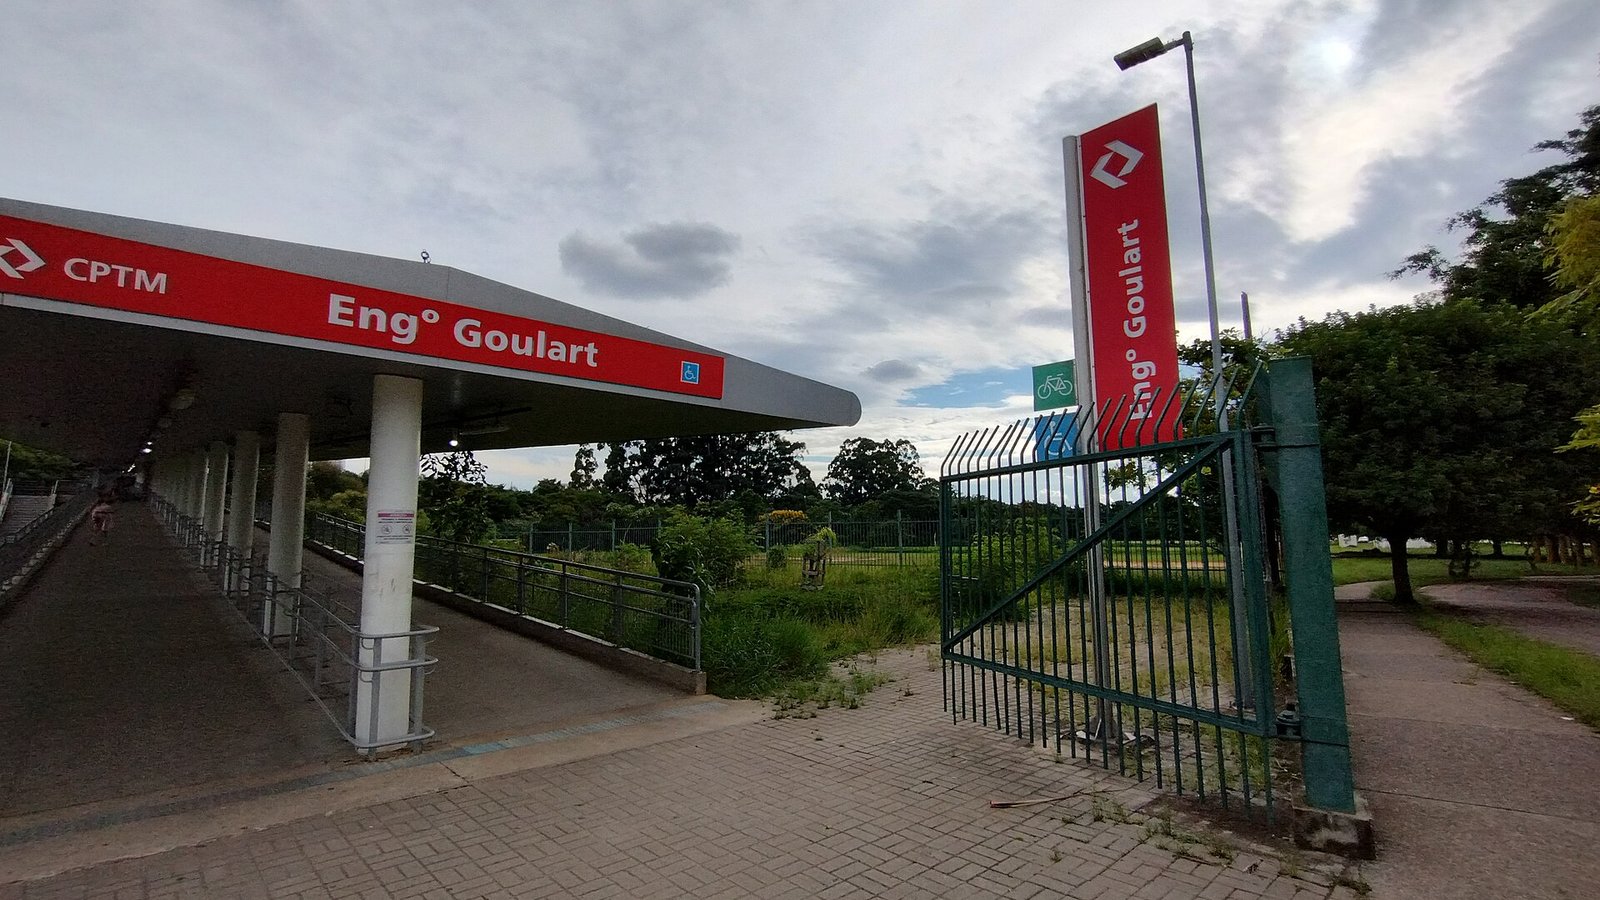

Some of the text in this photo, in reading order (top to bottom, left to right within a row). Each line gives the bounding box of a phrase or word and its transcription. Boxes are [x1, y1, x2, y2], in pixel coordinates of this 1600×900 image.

[63, 258, 167, 294] CPTM
[1117, 219, 1147, 338] Goulart
[453, 318, 599, 368] Goulart
